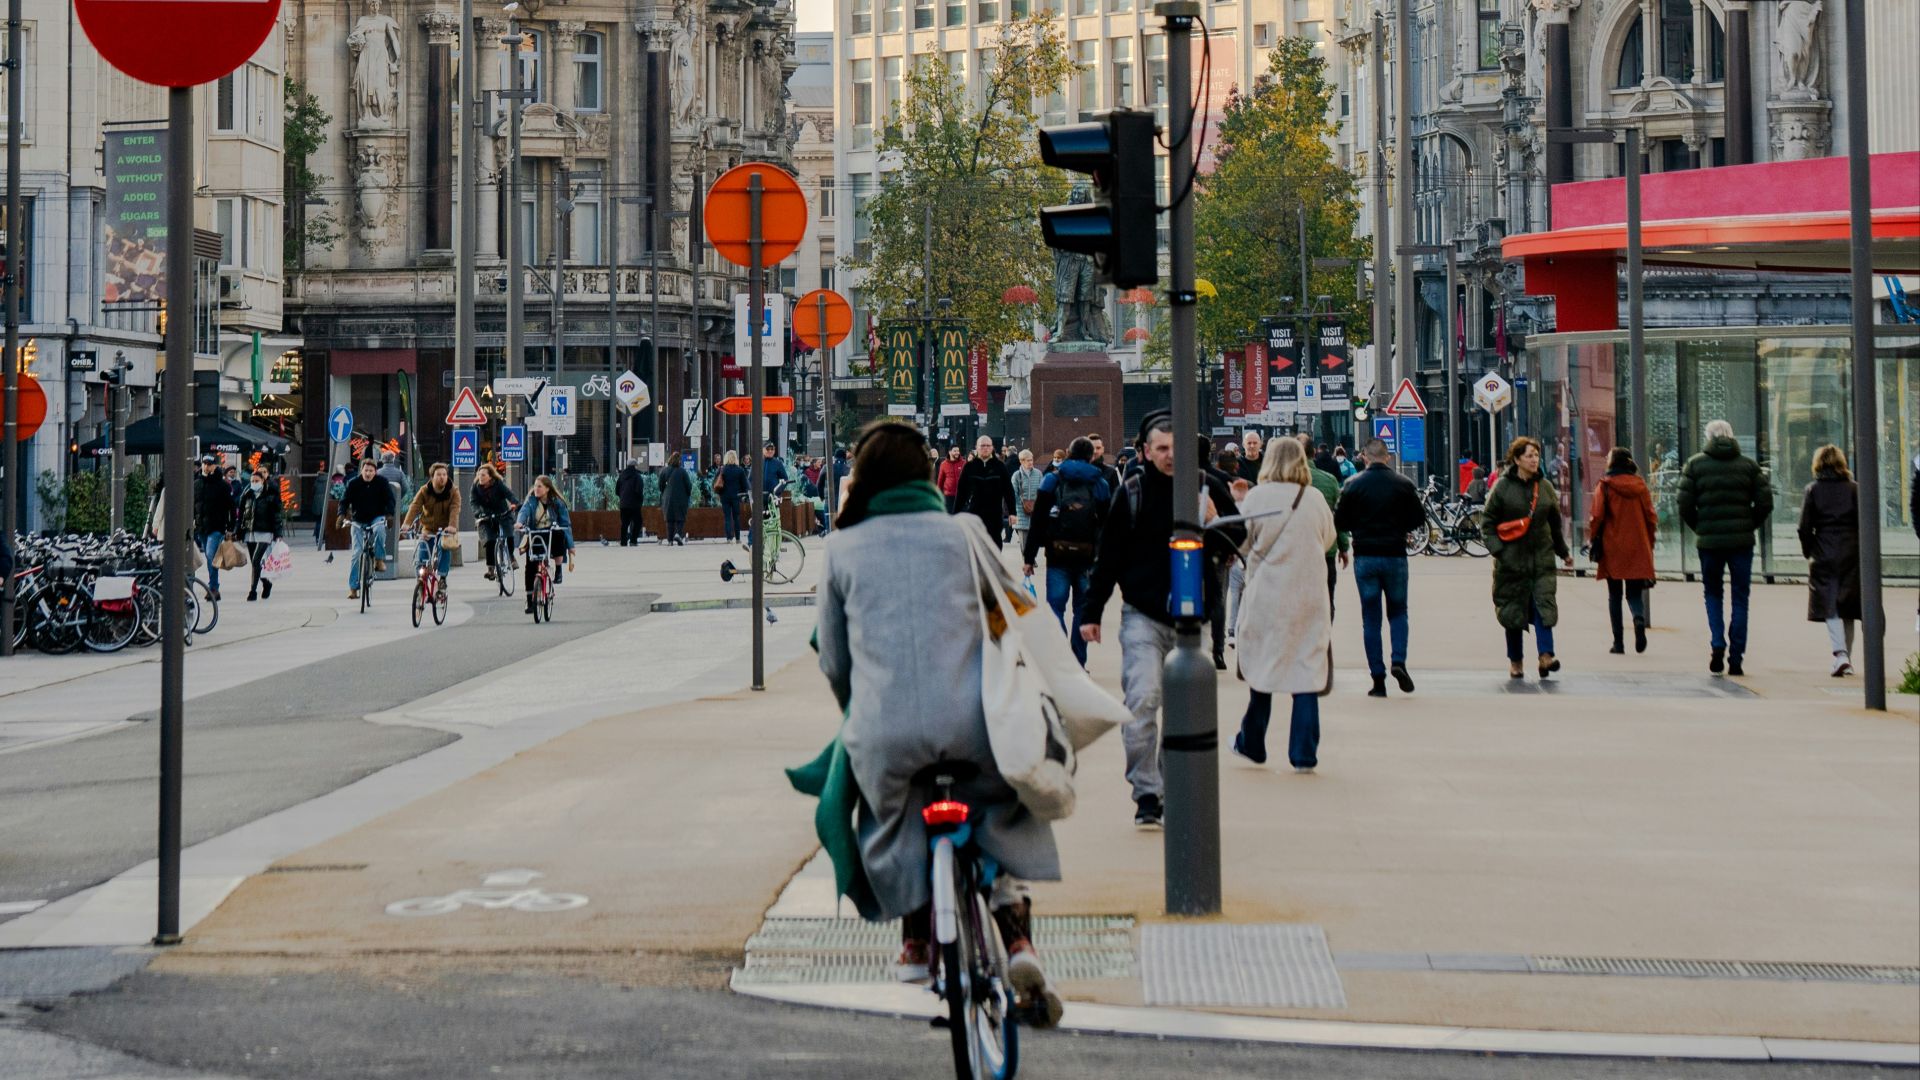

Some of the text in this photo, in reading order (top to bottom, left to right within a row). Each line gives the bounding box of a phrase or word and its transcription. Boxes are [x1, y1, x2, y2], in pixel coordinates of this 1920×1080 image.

[124, 136, 155, 145] ENTER
[117, 154, 162, 164] A WORLD
[116, 174, 163, 183] WITHOUT
[123, 192, 157, 202] ADDED
[120, 212, 160, 221] SUGARS
[1272, 329, 1291, 338] VISIT
[1322, 326, 1341, 337] VISIT
[1270, 339, 1293, 348] TODAY
[1320, 337, 1344, 346] TODAY
[1254, 345, 1262, 396] Vanden Borre
[252, 408, 294, 416] EXCHANGE
